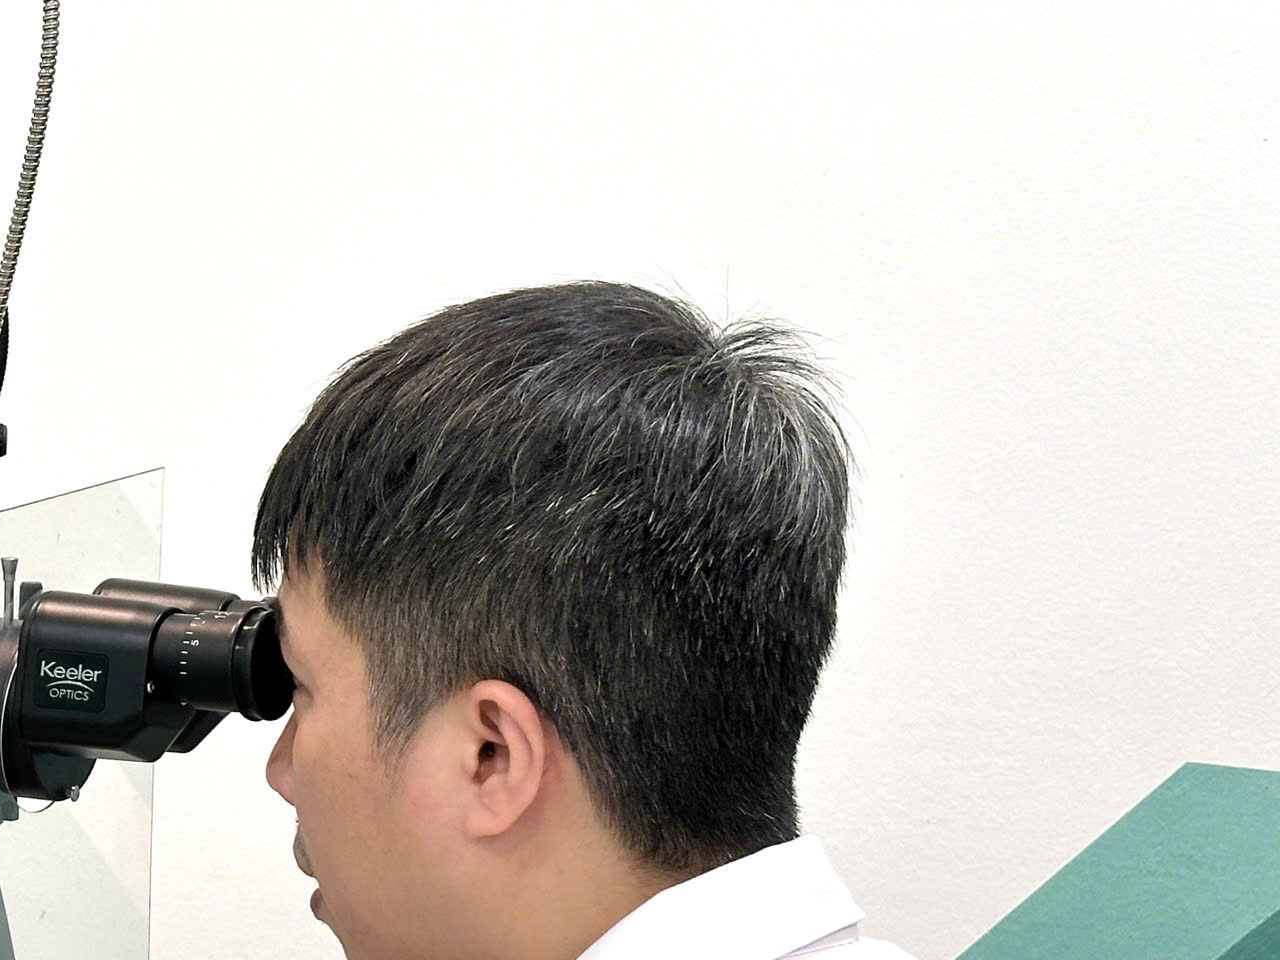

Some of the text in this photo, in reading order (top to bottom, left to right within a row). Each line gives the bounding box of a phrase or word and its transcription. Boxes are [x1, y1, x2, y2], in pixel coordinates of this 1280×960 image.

[190, 639, 200, 647] 5
[40, 660, 102, 682] Keeler
[49, 687, 89, 701] OPTICS
